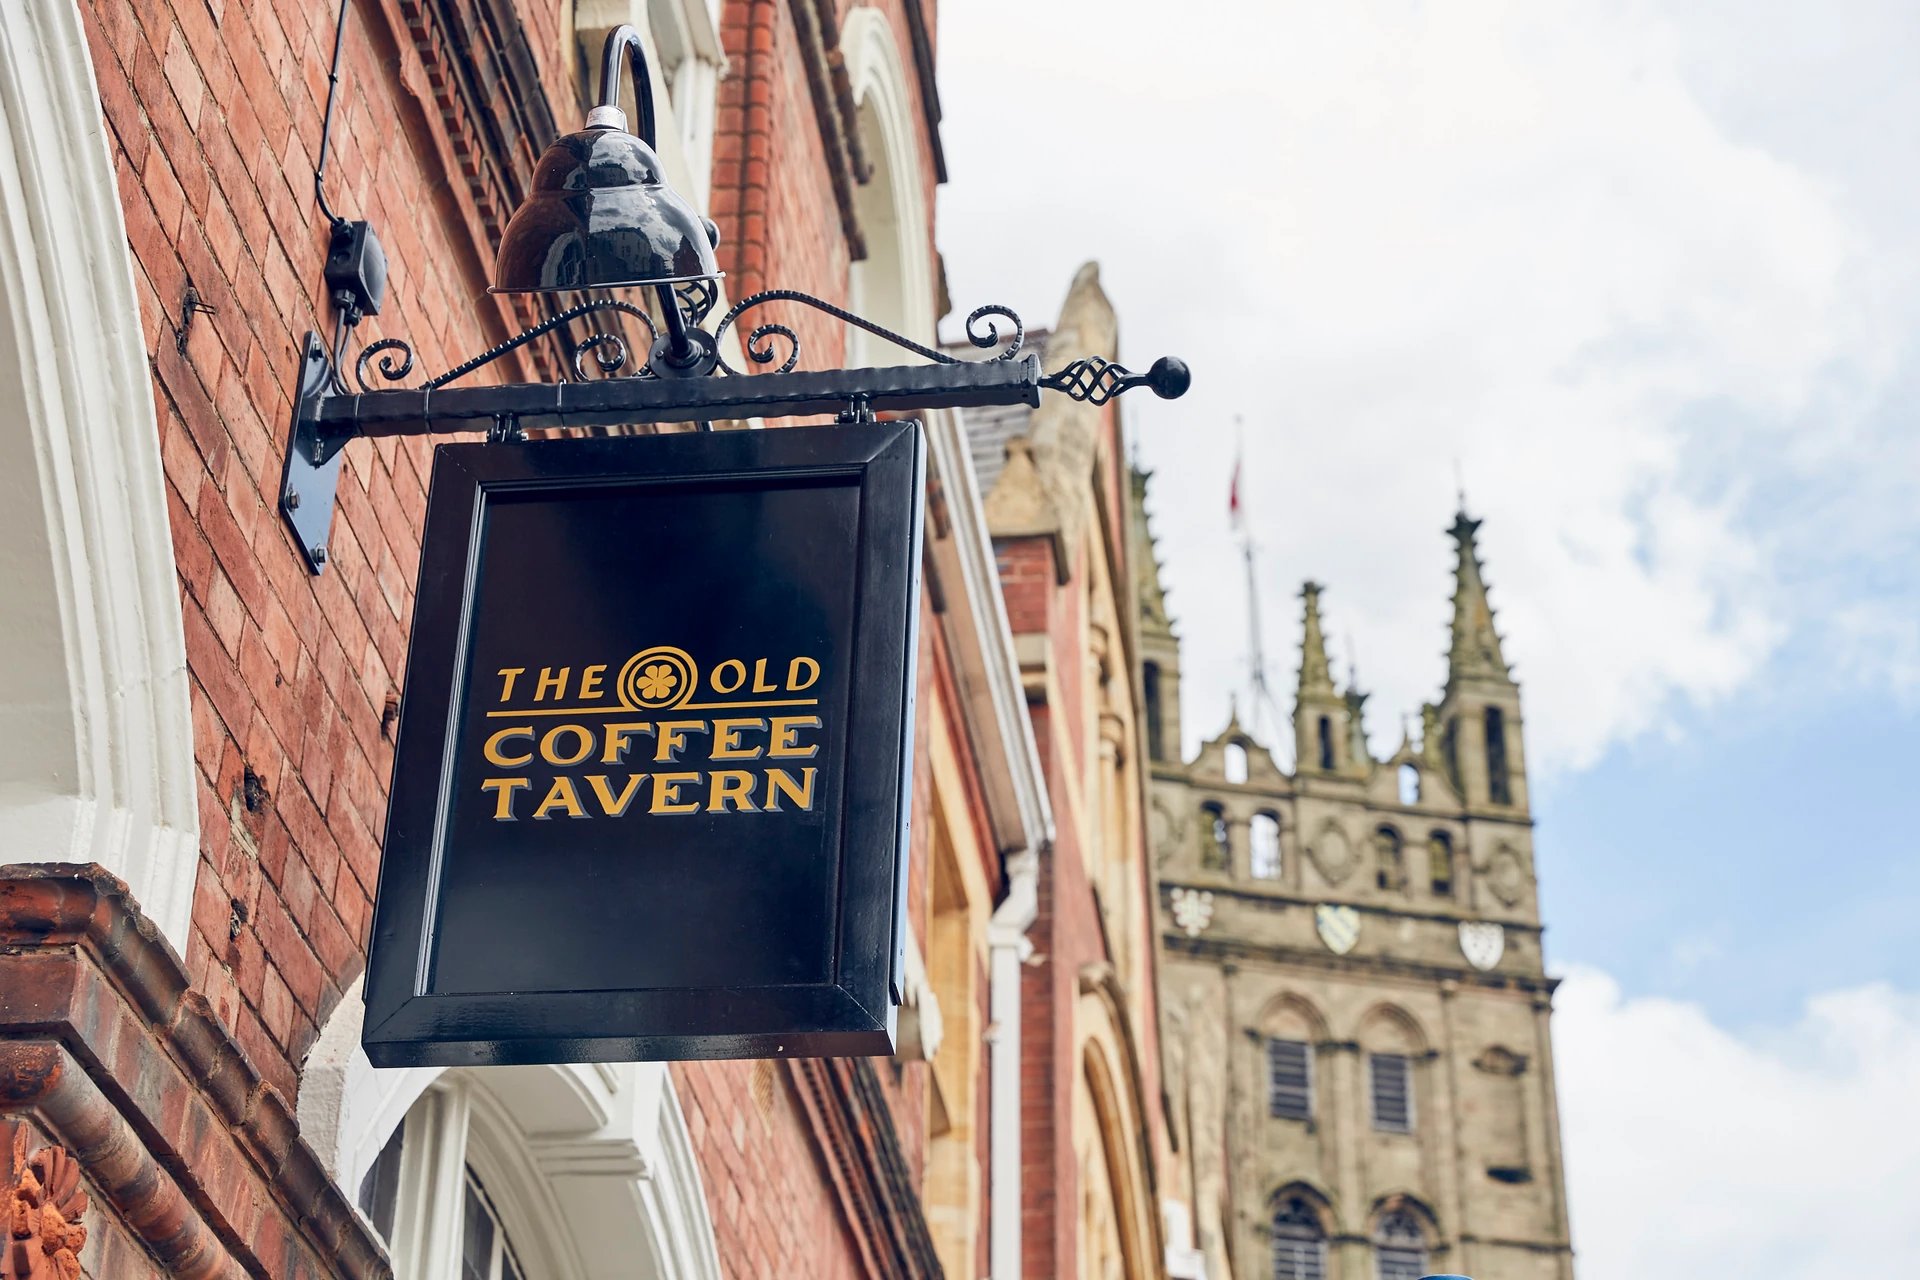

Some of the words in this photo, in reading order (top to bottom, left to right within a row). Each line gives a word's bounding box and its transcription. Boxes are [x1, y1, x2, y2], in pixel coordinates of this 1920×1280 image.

[497, 664, 607, 702] THE
[710, 656, 821, 694] OLD
[483, 716, 823, 767] COFFEE
[481, 767, 818, 821] TAVERN
